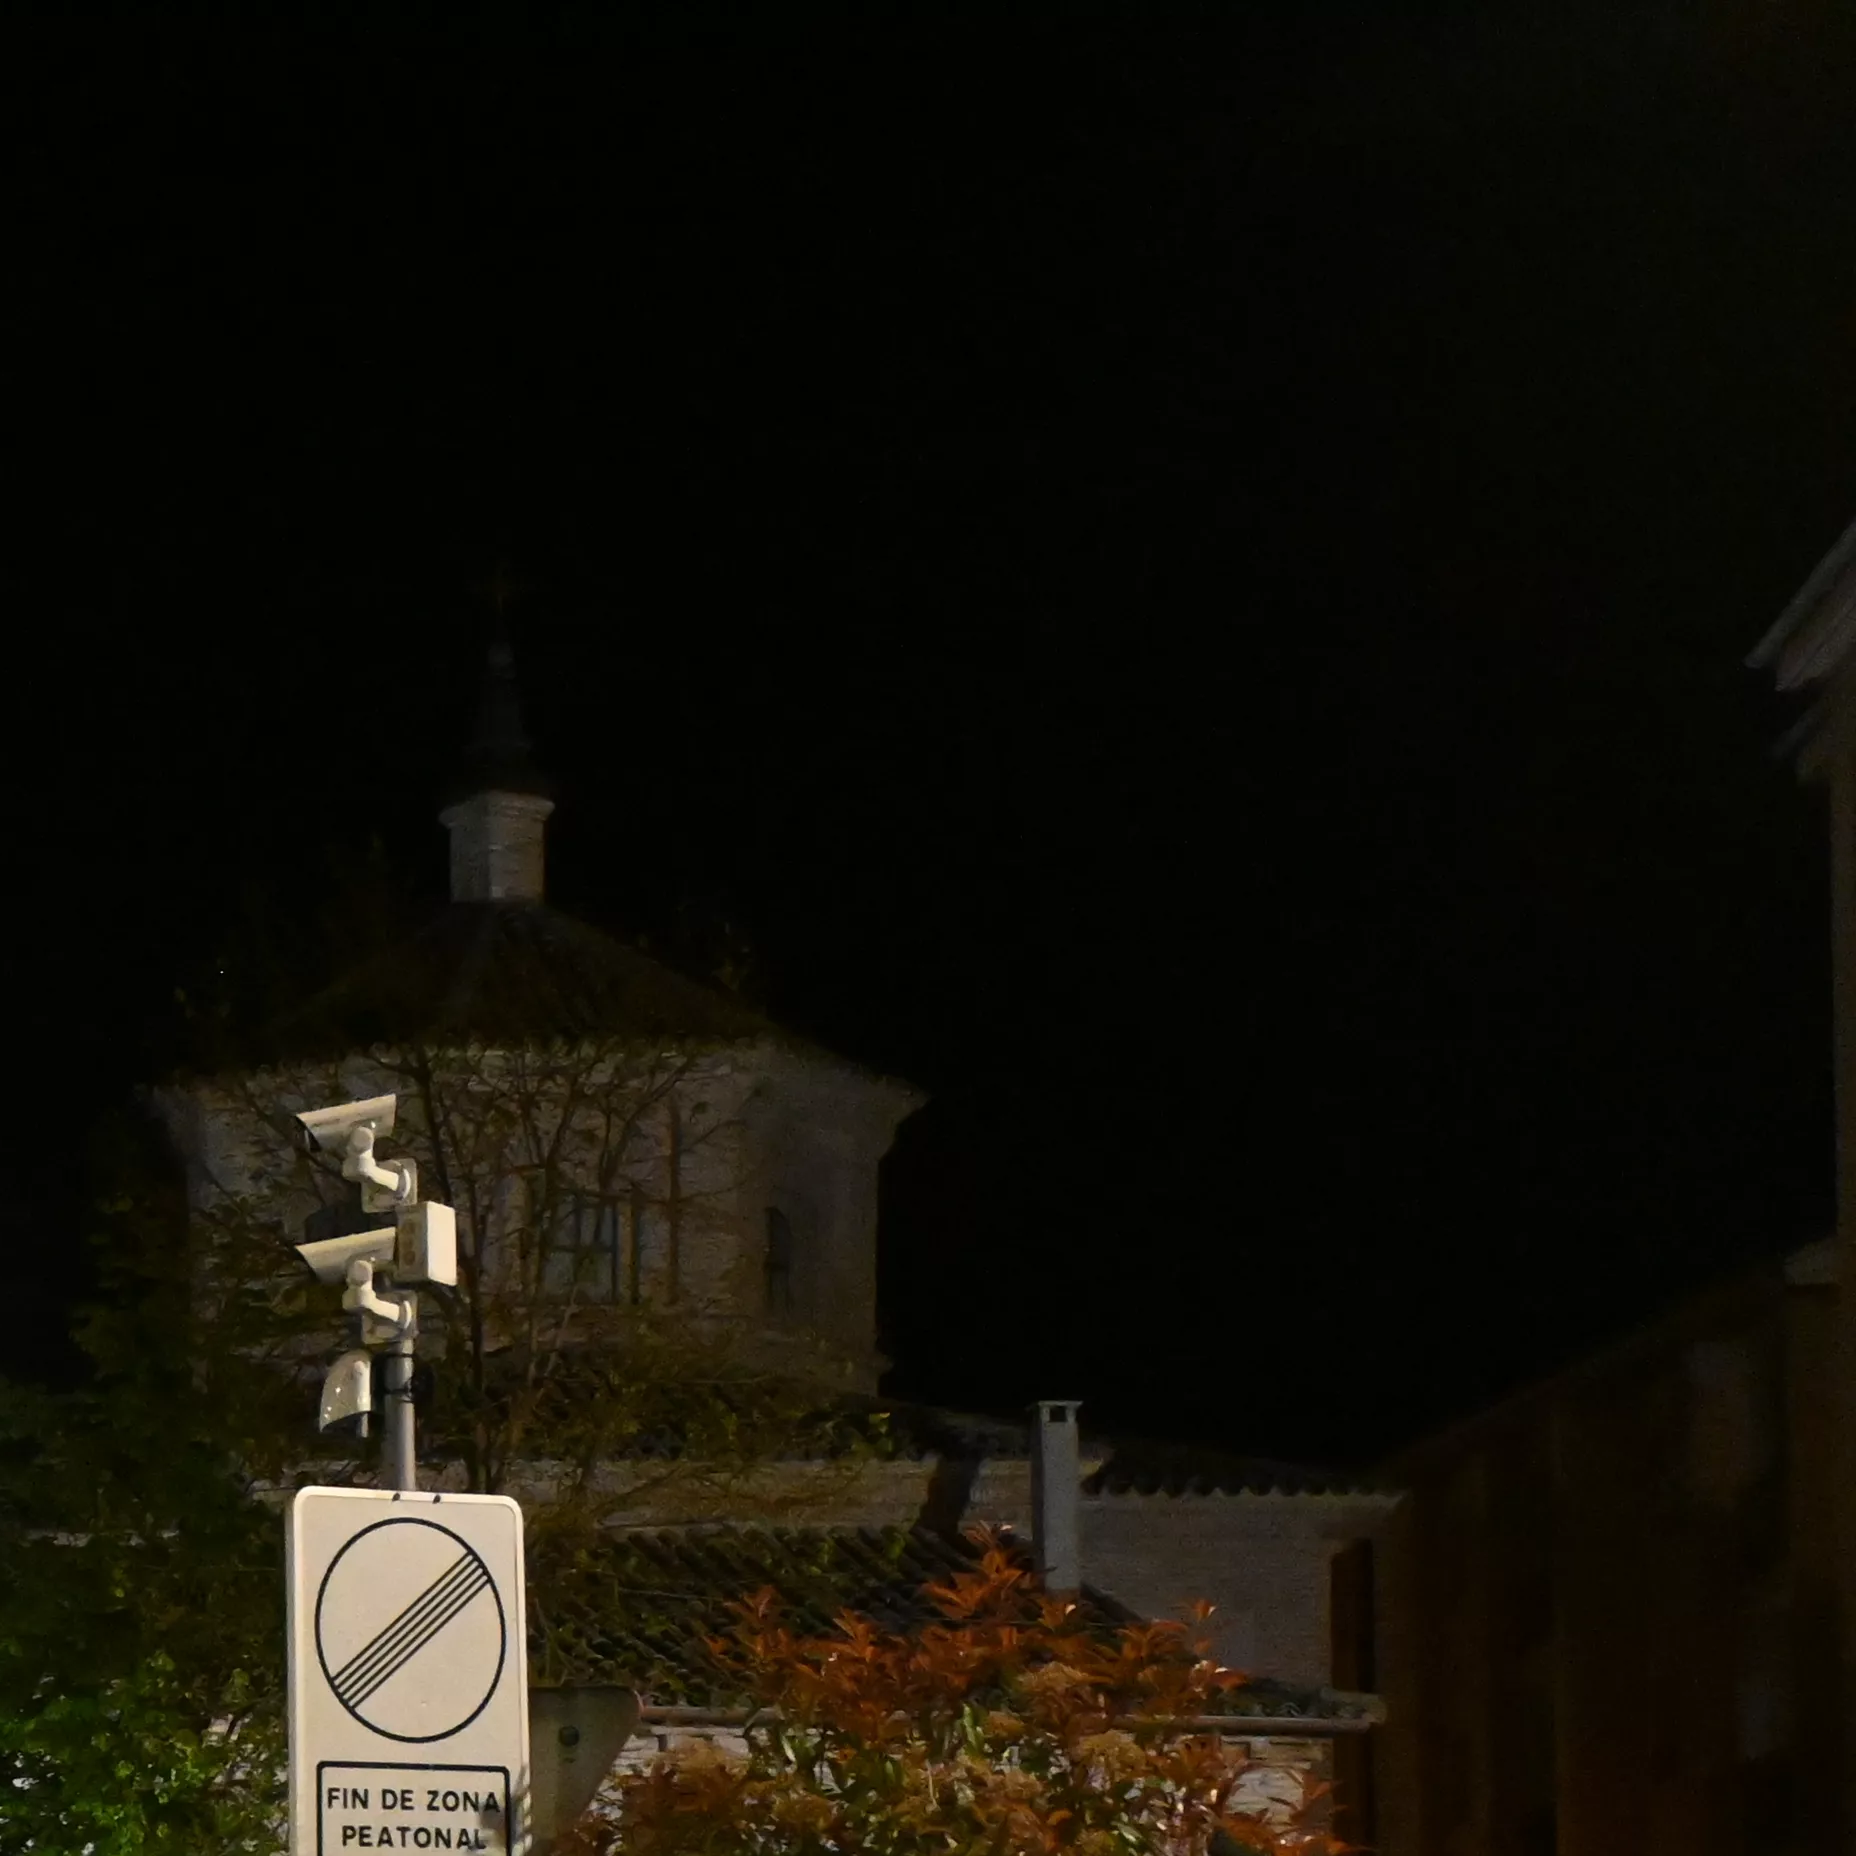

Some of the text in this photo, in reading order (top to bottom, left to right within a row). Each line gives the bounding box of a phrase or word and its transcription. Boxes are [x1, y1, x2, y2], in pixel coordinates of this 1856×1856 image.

[327, 1787, 501, 1814] FIN DE ZONA
[341, 1825, 487, 1850] PEATONAL
